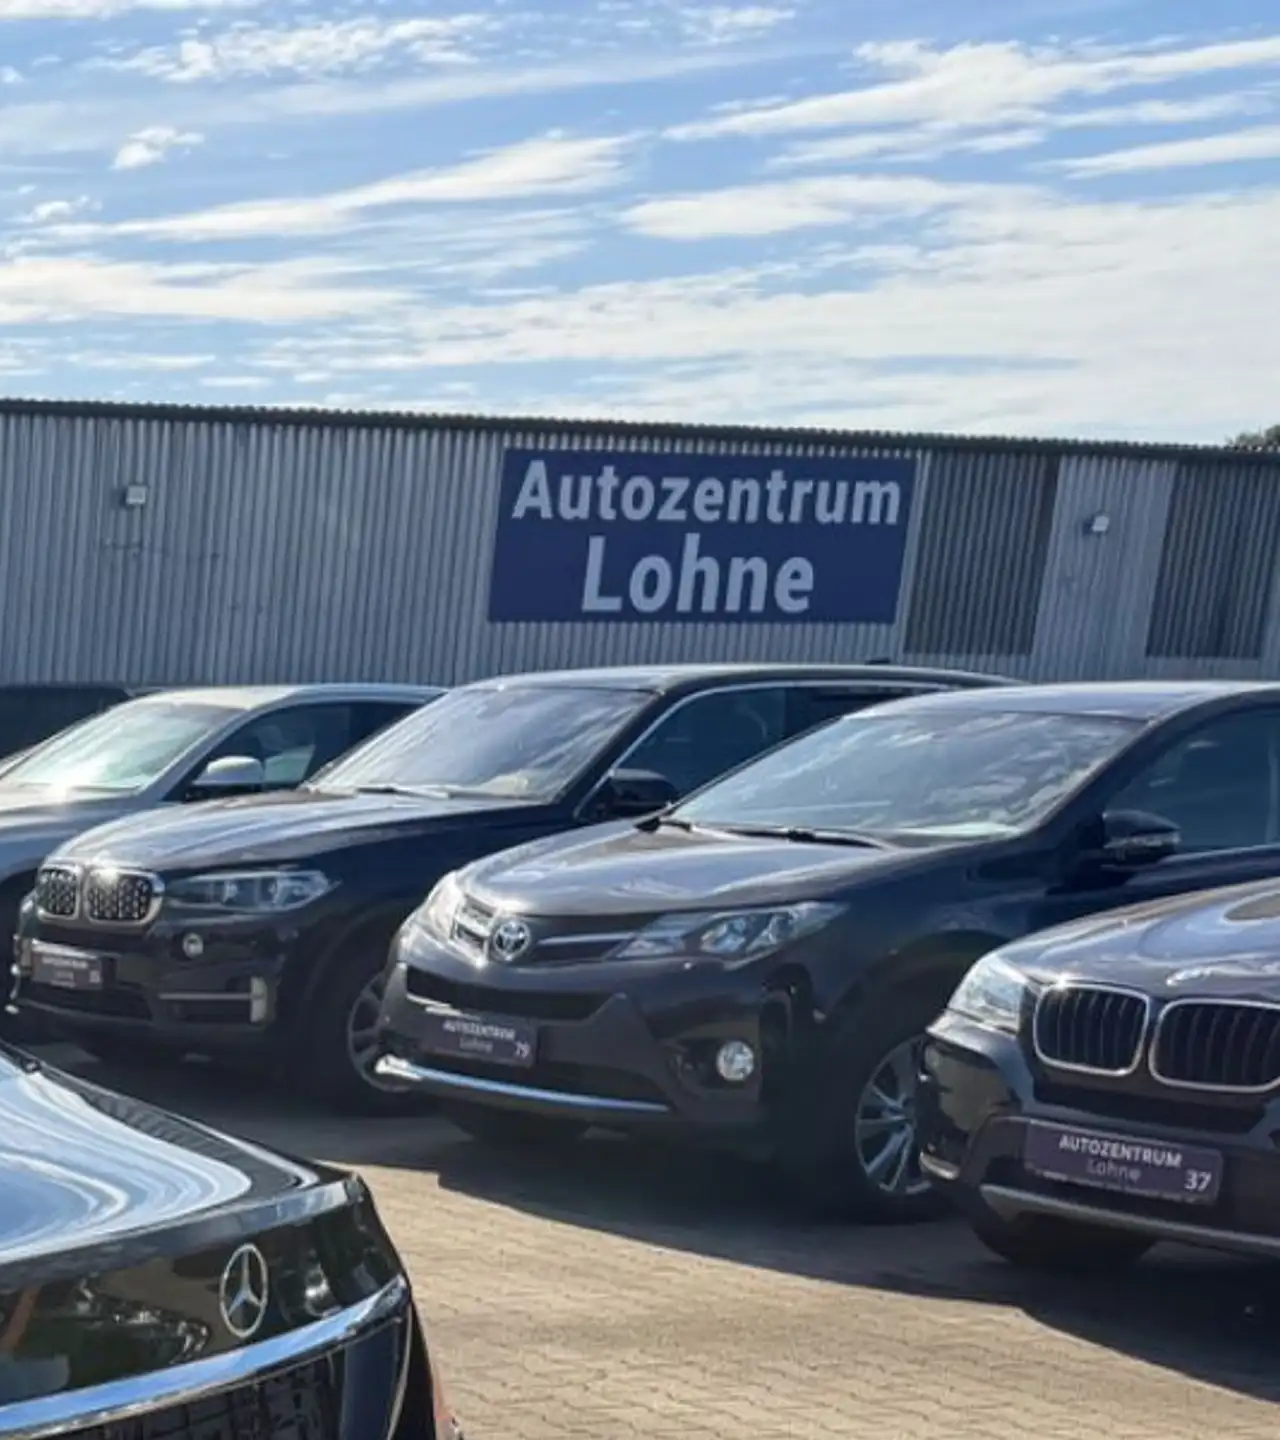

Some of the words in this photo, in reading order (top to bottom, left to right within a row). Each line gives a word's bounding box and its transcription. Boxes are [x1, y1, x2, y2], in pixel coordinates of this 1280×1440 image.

[512, 460, 901, 525] Autozentrum
[581, 532, 815, 614] Lohne
[1058, 1134, 1183, 1168] AUTOZENTRUM
[1184, 1169, 1213, 1192] 37
